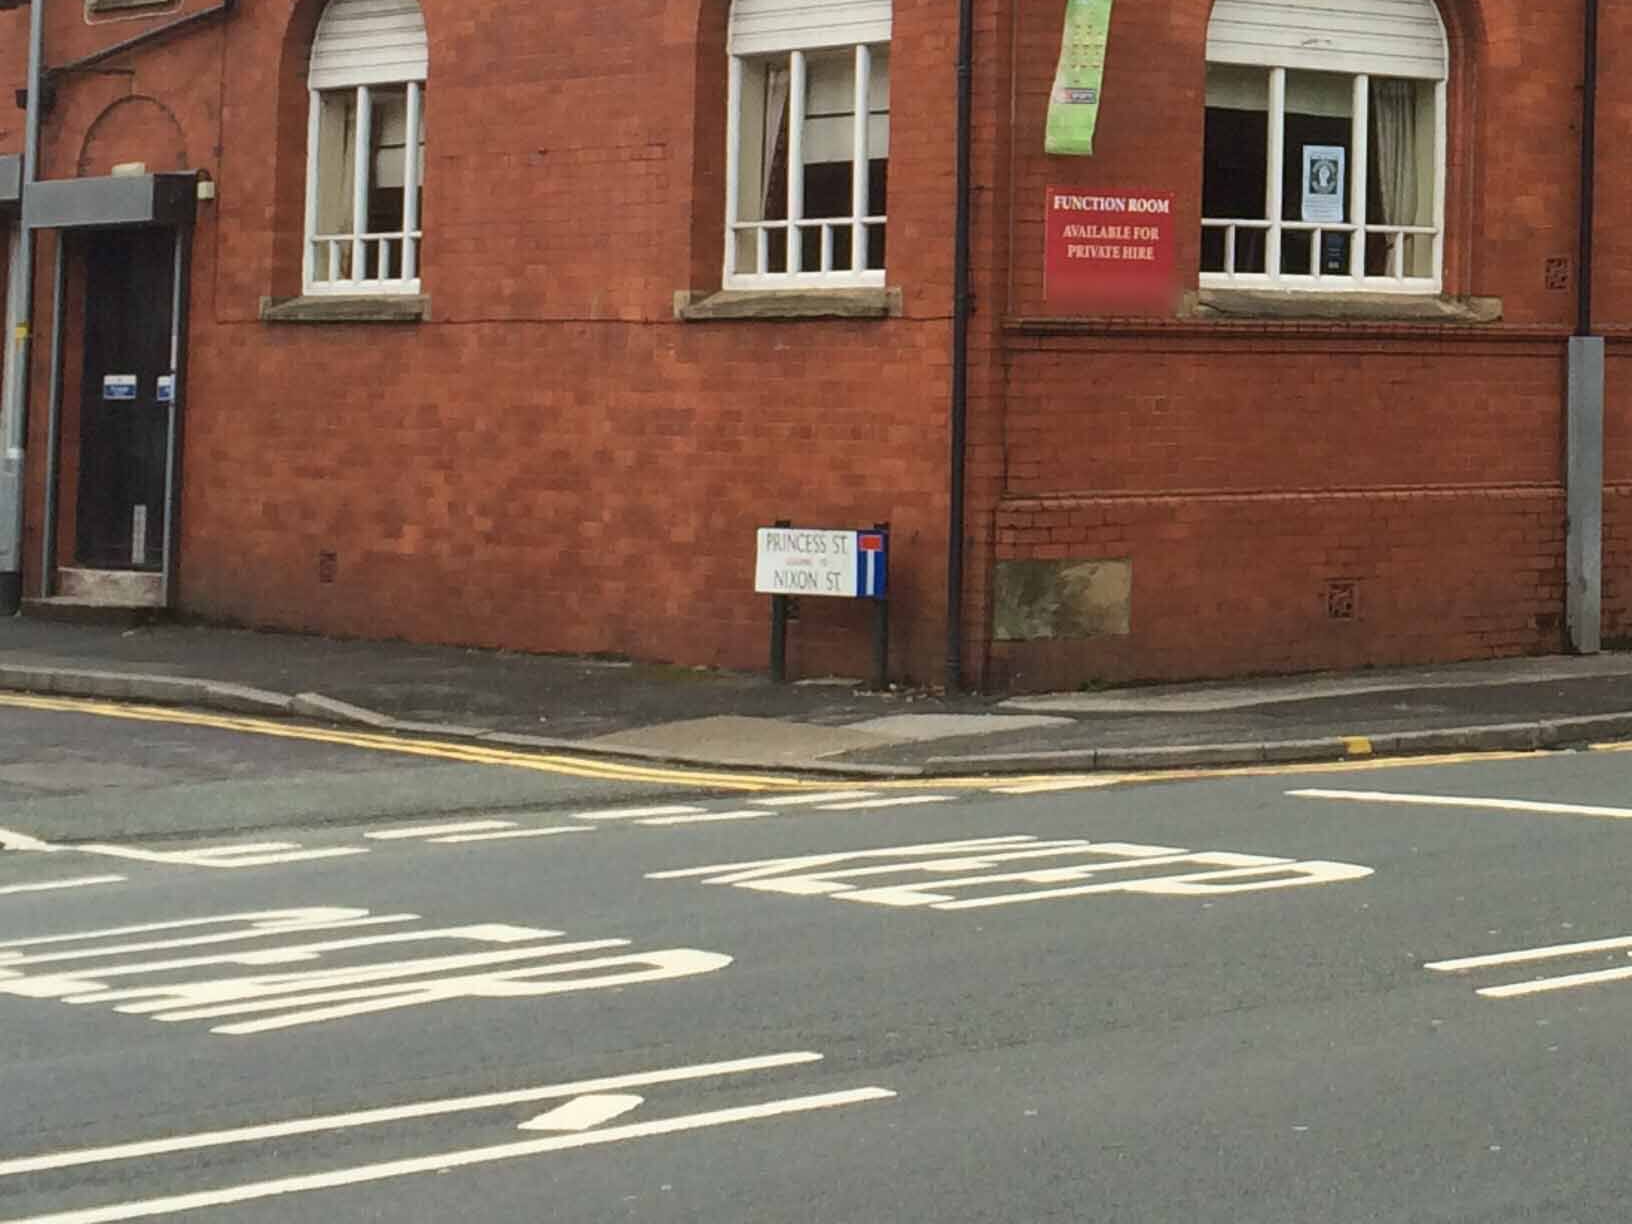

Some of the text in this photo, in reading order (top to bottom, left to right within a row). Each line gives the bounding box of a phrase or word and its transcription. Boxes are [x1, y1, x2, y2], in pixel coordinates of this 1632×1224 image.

[1054, 195, 1170, 213] FUNCTION ROOM
[1063, 224, 1160, 240] AVAILABLE FOR
[1067, 244, 1155, 261] PRIVATE HIRE
[766, 533, 826, 554] PRINCESS
[773, 569, 817, 591] NIXON
[644, 835, 1375, 910] KEEP
